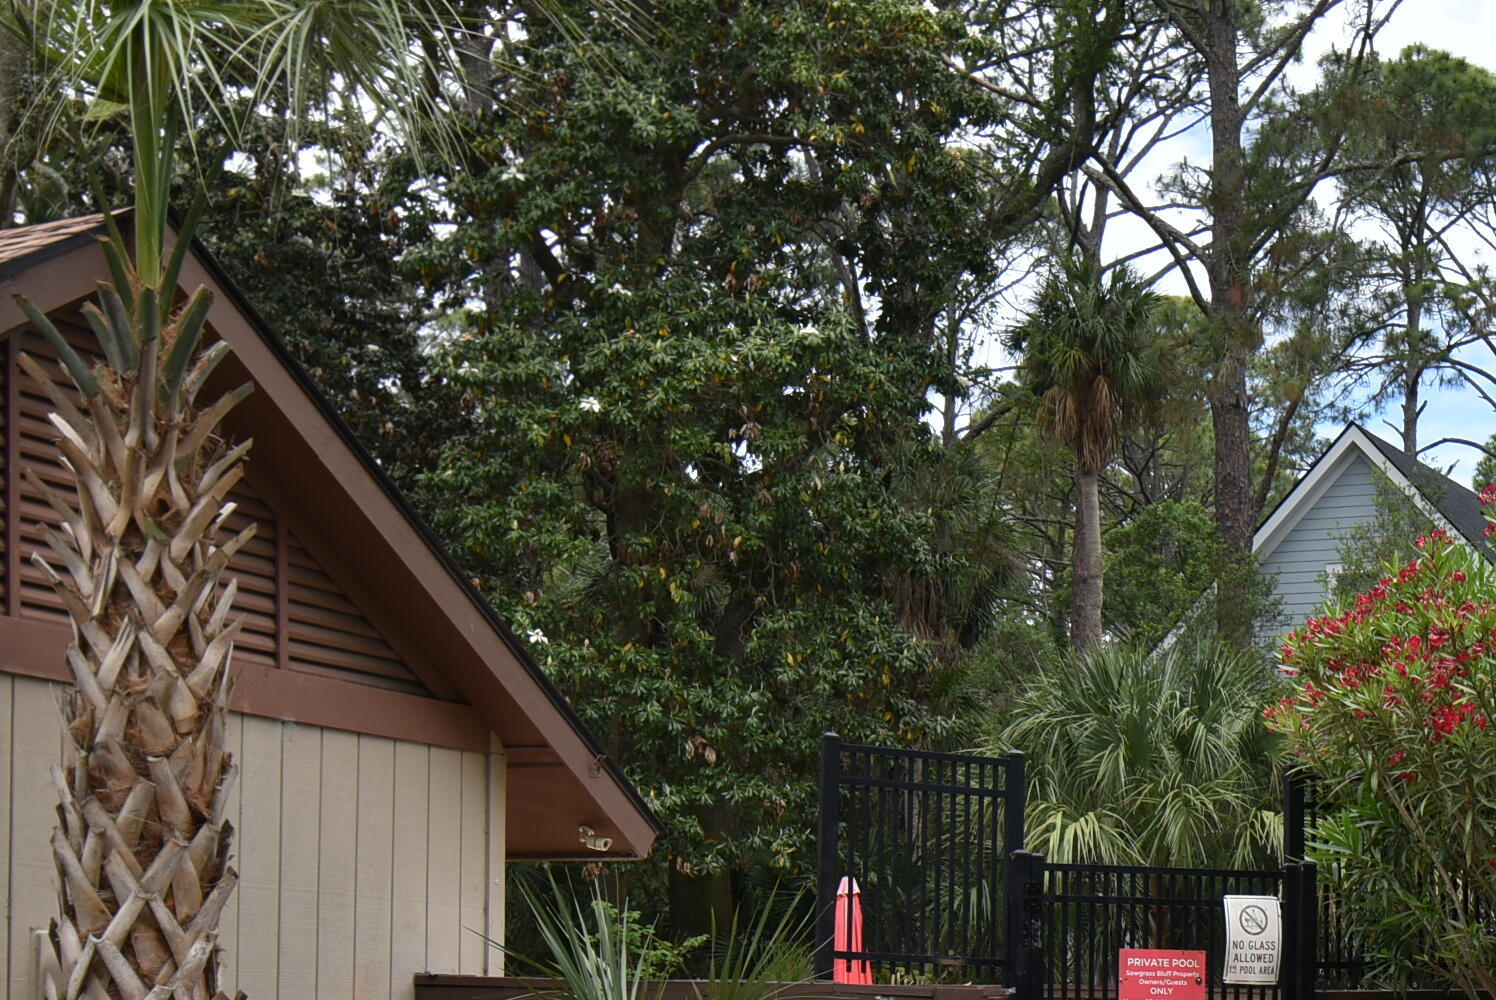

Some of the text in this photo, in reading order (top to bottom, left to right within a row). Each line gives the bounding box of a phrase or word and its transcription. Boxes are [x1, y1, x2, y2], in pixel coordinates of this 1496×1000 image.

[1232, 940, 1276, 951] NO GLASS
[1127, 957, 1200, 968] PRIVATE POOL
[1232, 953, 1274, 963] ALLOWED
[1126, 970, 1156, 978] Sawgrass
[1172, 970, 1200, 979] Property
[1240, 966, 1257, 974] POOL
[1258, 966, 1275, 975] AREA
[1150, 987, 1174, 995] ONLY
